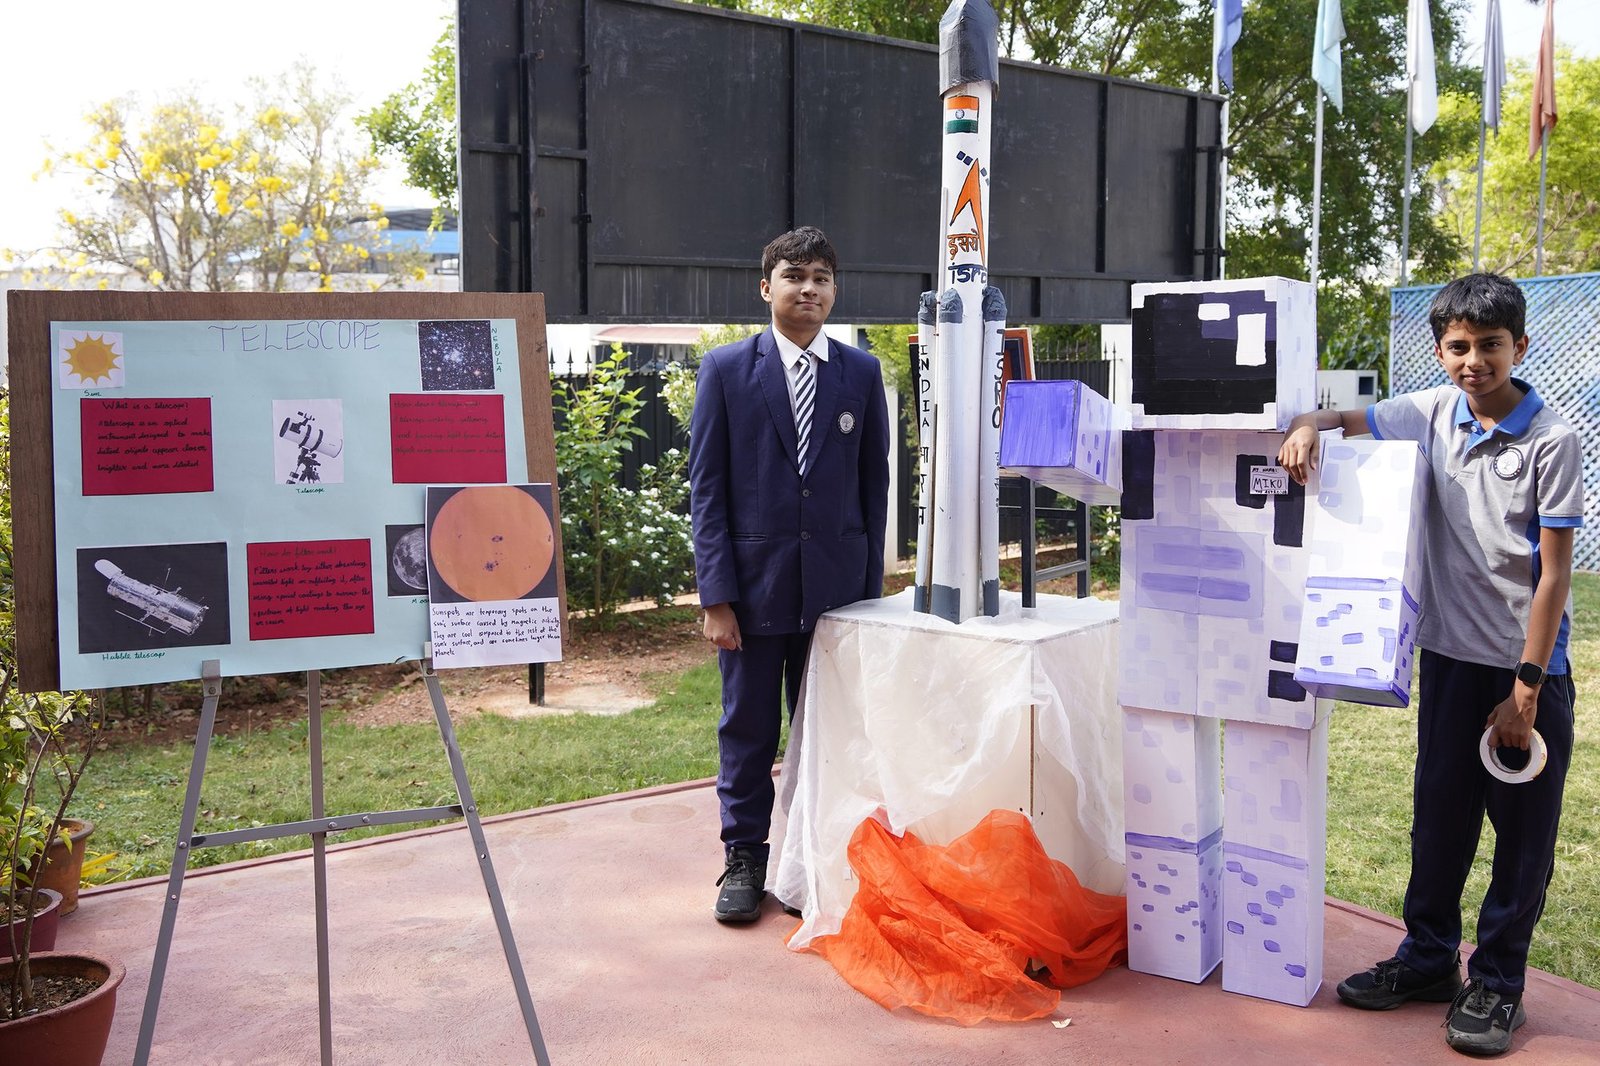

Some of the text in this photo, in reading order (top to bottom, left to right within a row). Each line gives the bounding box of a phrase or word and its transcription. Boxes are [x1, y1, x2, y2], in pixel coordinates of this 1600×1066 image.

[207, 320, 381, 352] TELESCOPE
[491, 327, 503, 373] NEBULA
[919, 344, 931, 428] INDIA
[102, 401, 128, 409] What
[432, 606, 460, 618] Sunspots
[500, 618, 508, 628] by
